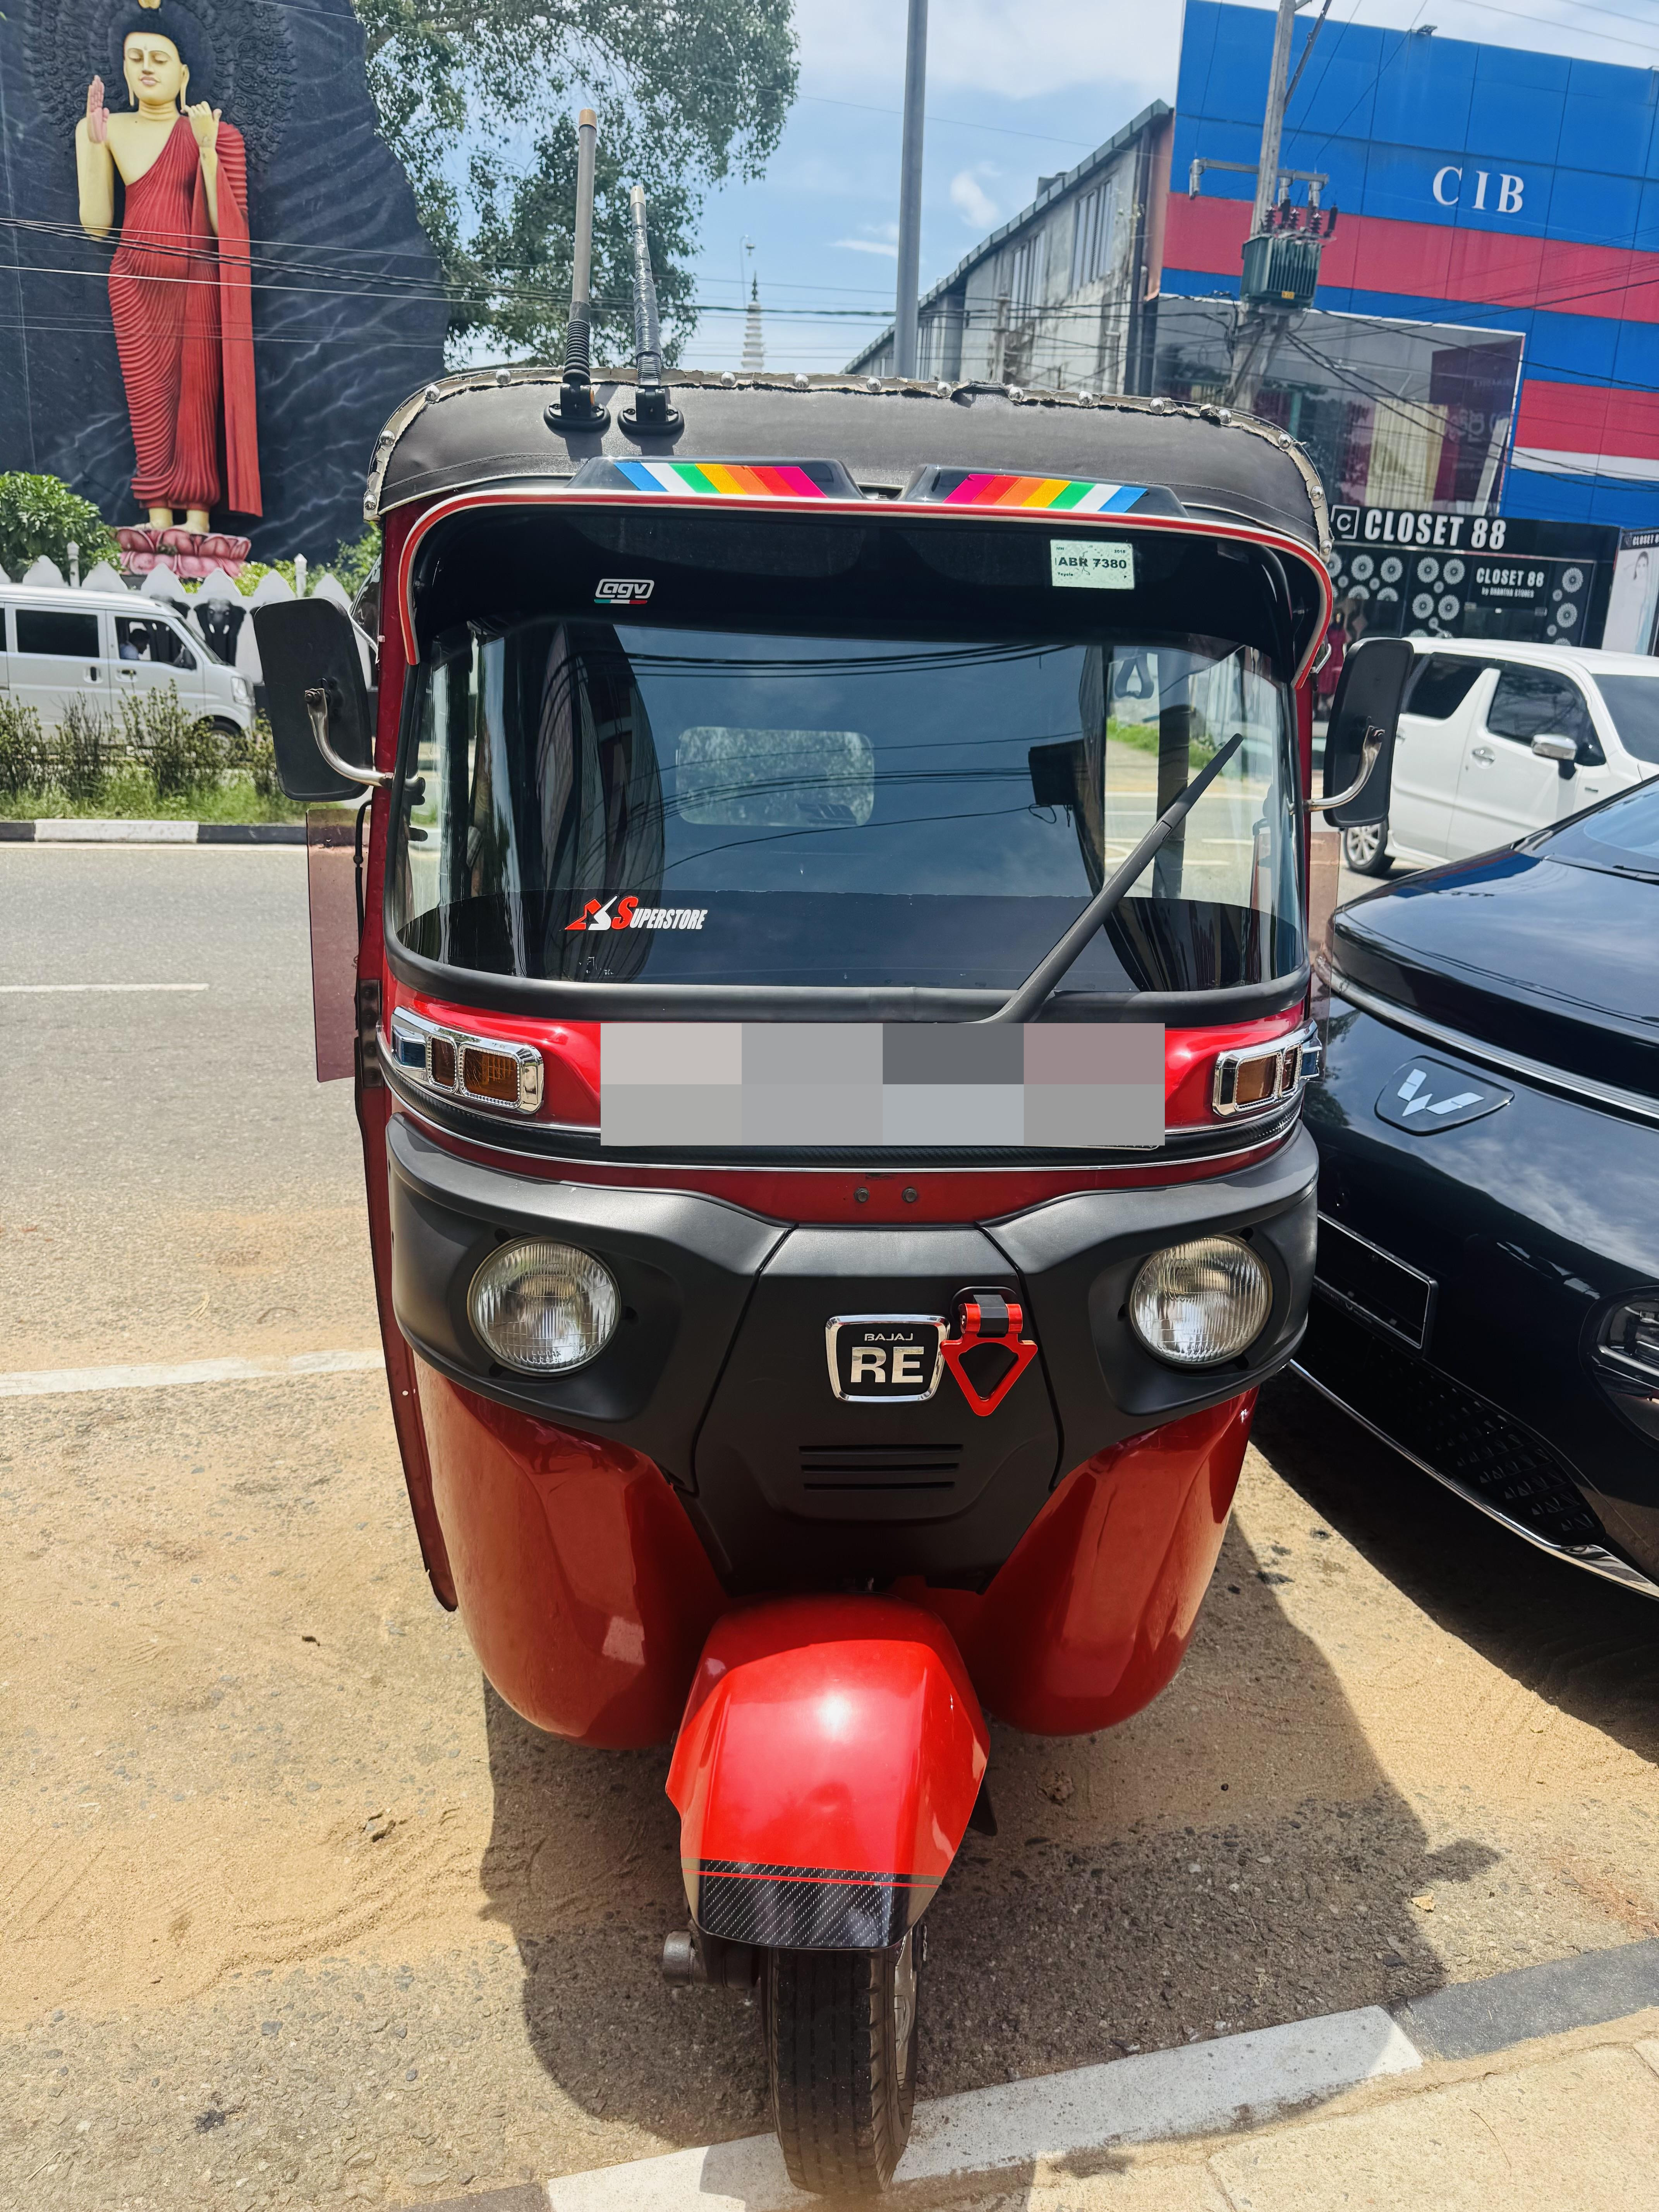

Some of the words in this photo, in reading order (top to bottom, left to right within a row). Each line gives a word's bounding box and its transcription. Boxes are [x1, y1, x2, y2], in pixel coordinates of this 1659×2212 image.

[1433, 166, 1524, 213] CIB
[1364, 509, 1464, 546] CLOSET
[1471, 518, 1506, 550] 88
[1058, 556, 1089, 567] ABR
[1092, 558, 1127, 569] 7380
[603, 583, 647, 598] agv
[1476, 567, 1525, 586] CLOSET
[1527, 570, 1545, 588] 88
[611, 895, 709, 930] SUPERSTORE
[864, 1333, 914, 1341] BAJAJ
[850, 1346, 924, 1383] RE
